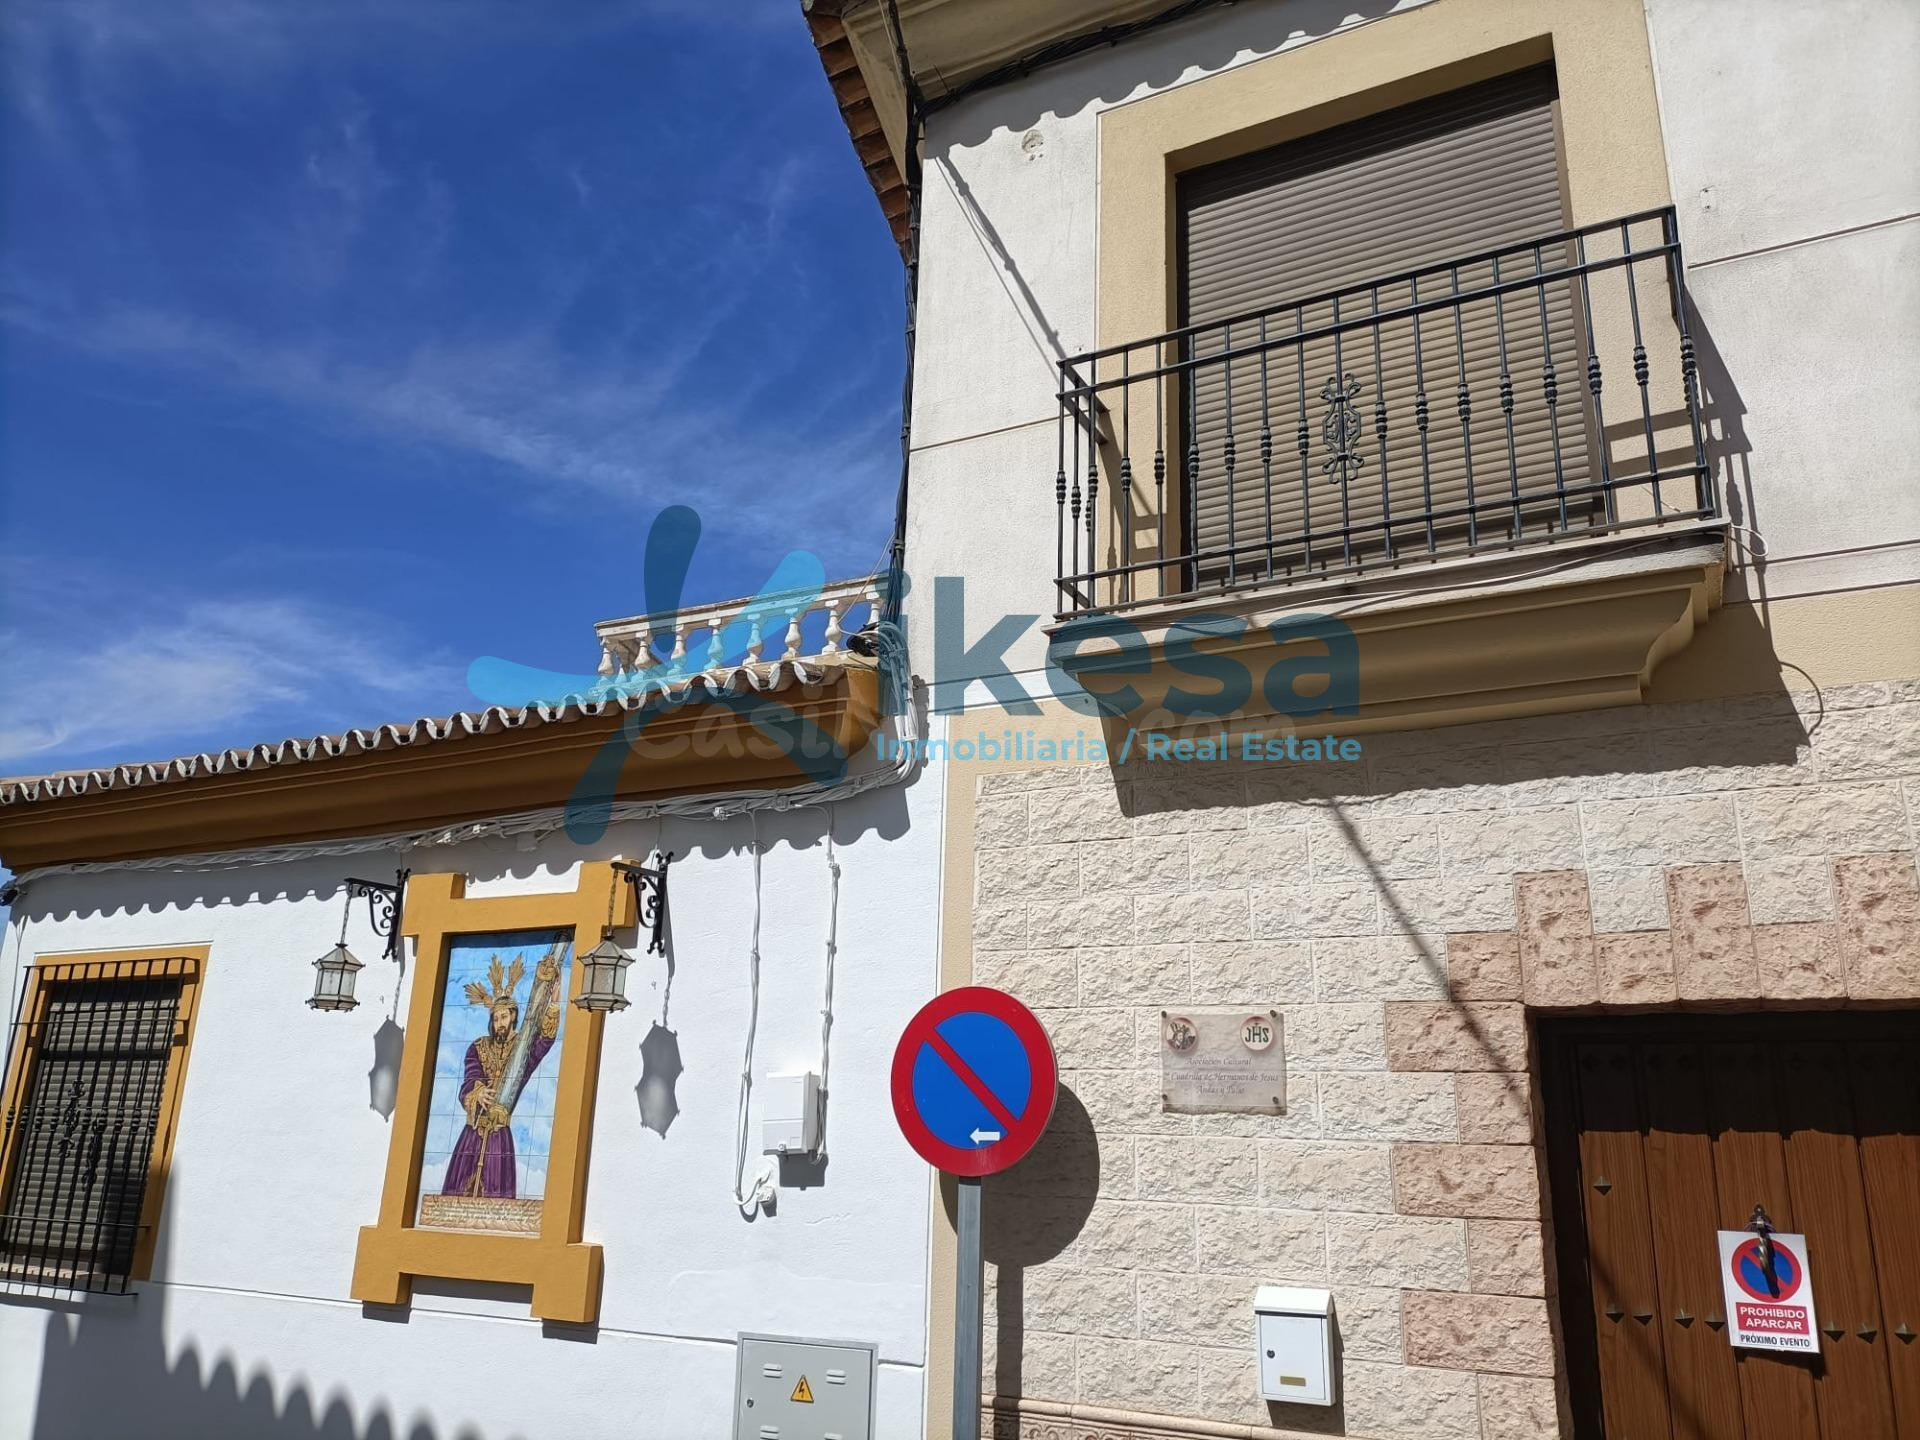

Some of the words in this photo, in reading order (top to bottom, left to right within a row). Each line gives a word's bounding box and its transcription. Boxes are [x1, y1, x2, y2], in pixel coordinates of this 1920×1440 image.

[1740, 1306, 1805, 1319] PROHIBIDO
[1745, 1318, 1802, 1330] APARCAR
[1740, 1333, 1777, 1345] PRÓXIMO
[1779, 1337, 1810, 1348] EVENTO
